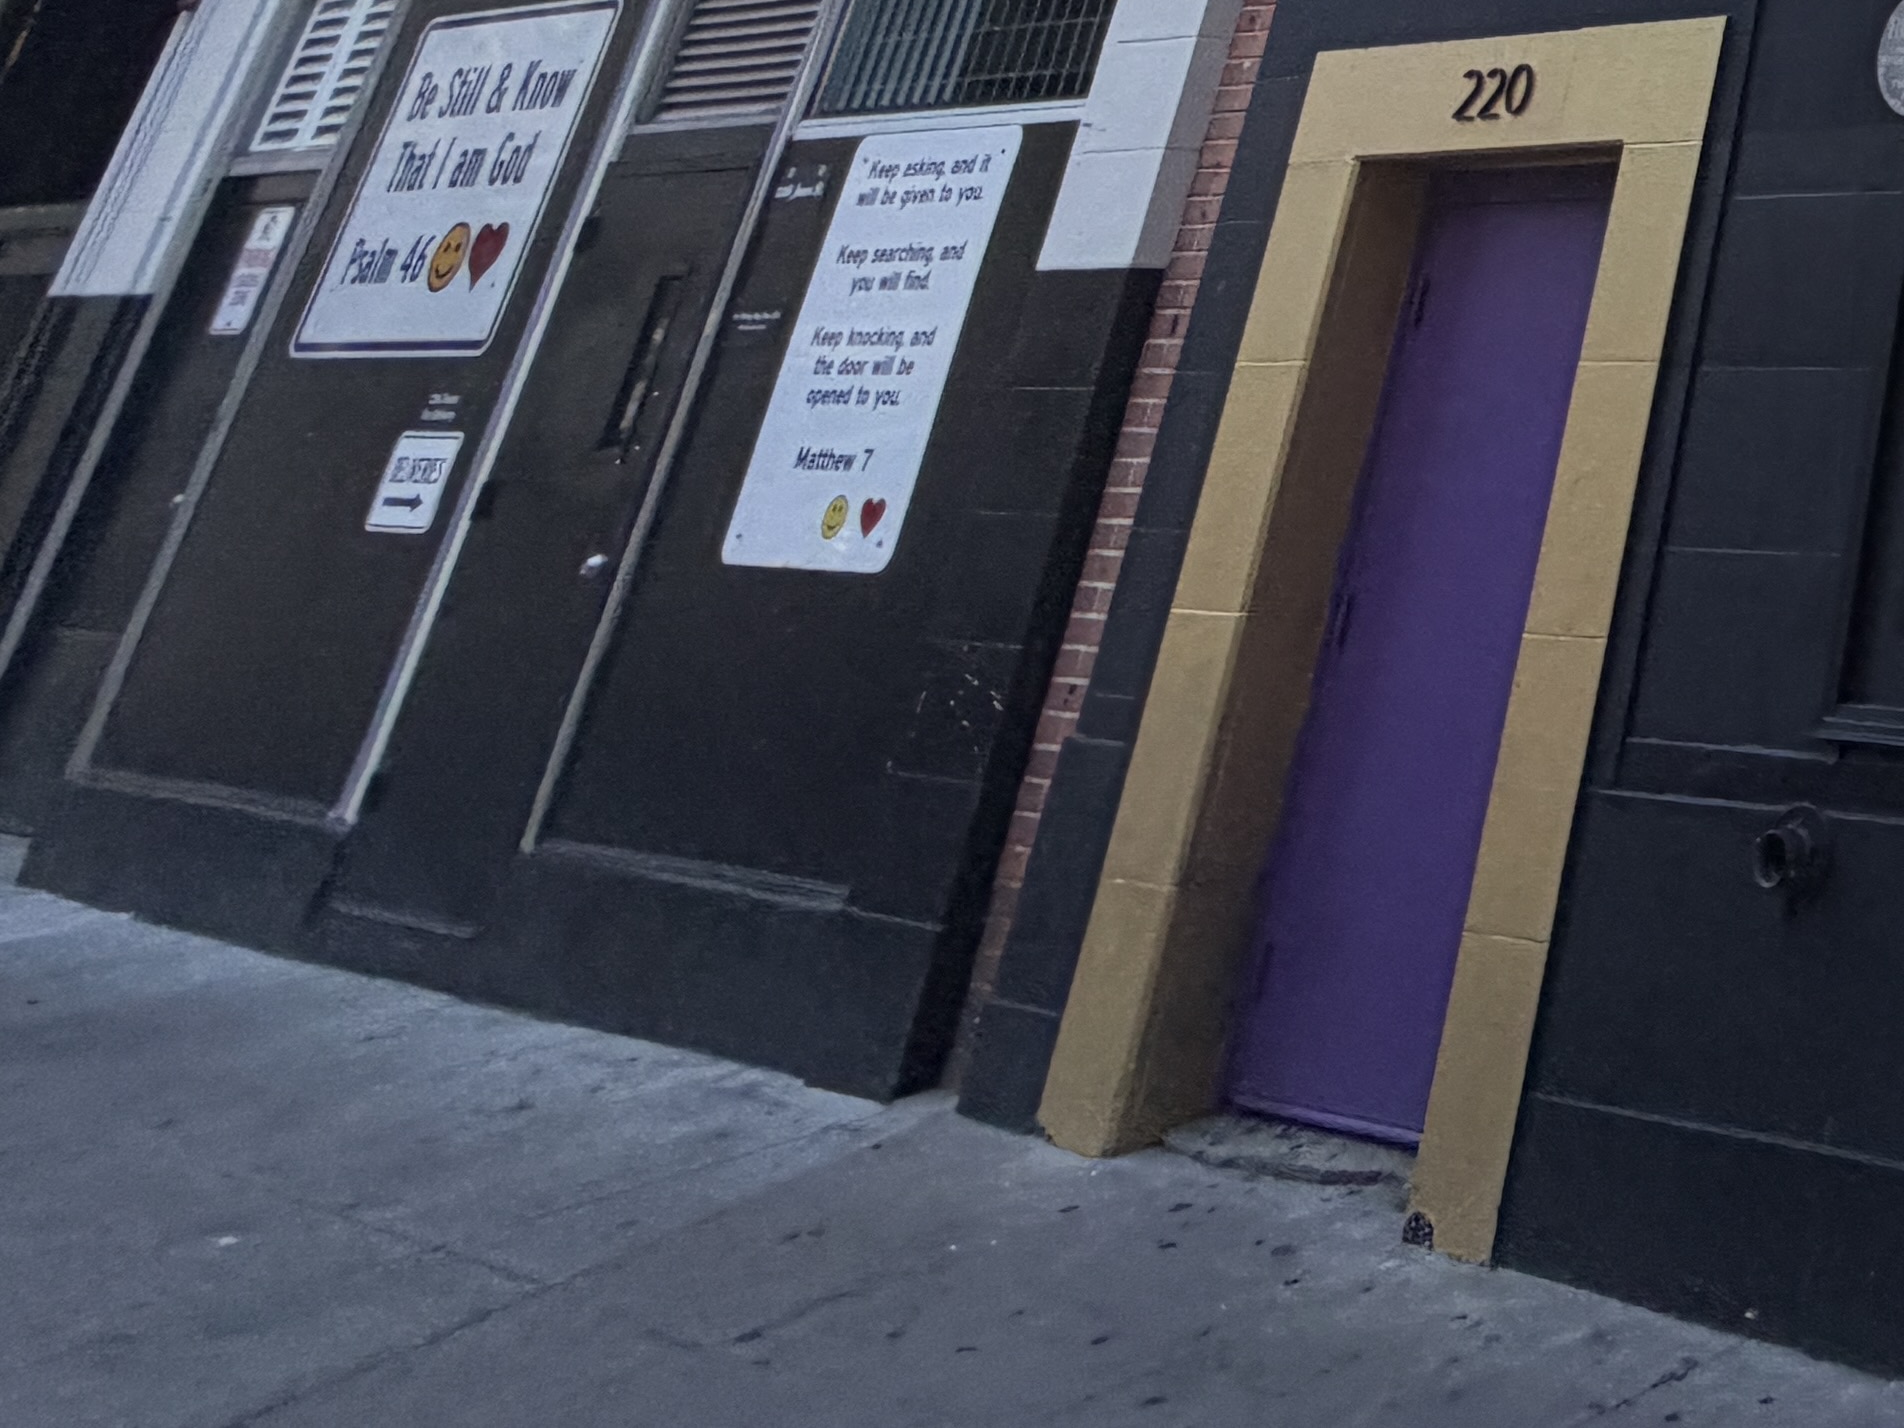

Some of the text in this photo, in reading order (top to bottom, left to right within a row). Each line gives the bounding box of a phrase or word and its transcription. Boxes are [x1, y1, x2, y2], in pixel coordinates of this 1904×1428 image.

[407, 59, 578, 122] Be Still & Know
[1450, 63, 1535, 123] 220
[387, 129, 543, 193] That I am God
[867, 158, 902, 181] Keep
[950, 156, 977, 175] and
[855, 186, 880, 207] will
[879, 186, 898, 206] be
[938, 184, 953, 203] to
[340, 235, 437, 286] Psalm 46
[836, 244, 869, 269] Keep
[939, 240, 969, 262] and
[849, 274, 876, 297] you
[877, 271, 902, 291] will
[810, 325, 844, 352] Keep
[909, 325, 938, 346] and
[813, 354, 915, 376] the door will be
[806, 385, 854, 410] opened
[855, 385, 869, 406] to
[793, 446, 875, 473] Matthew 7
